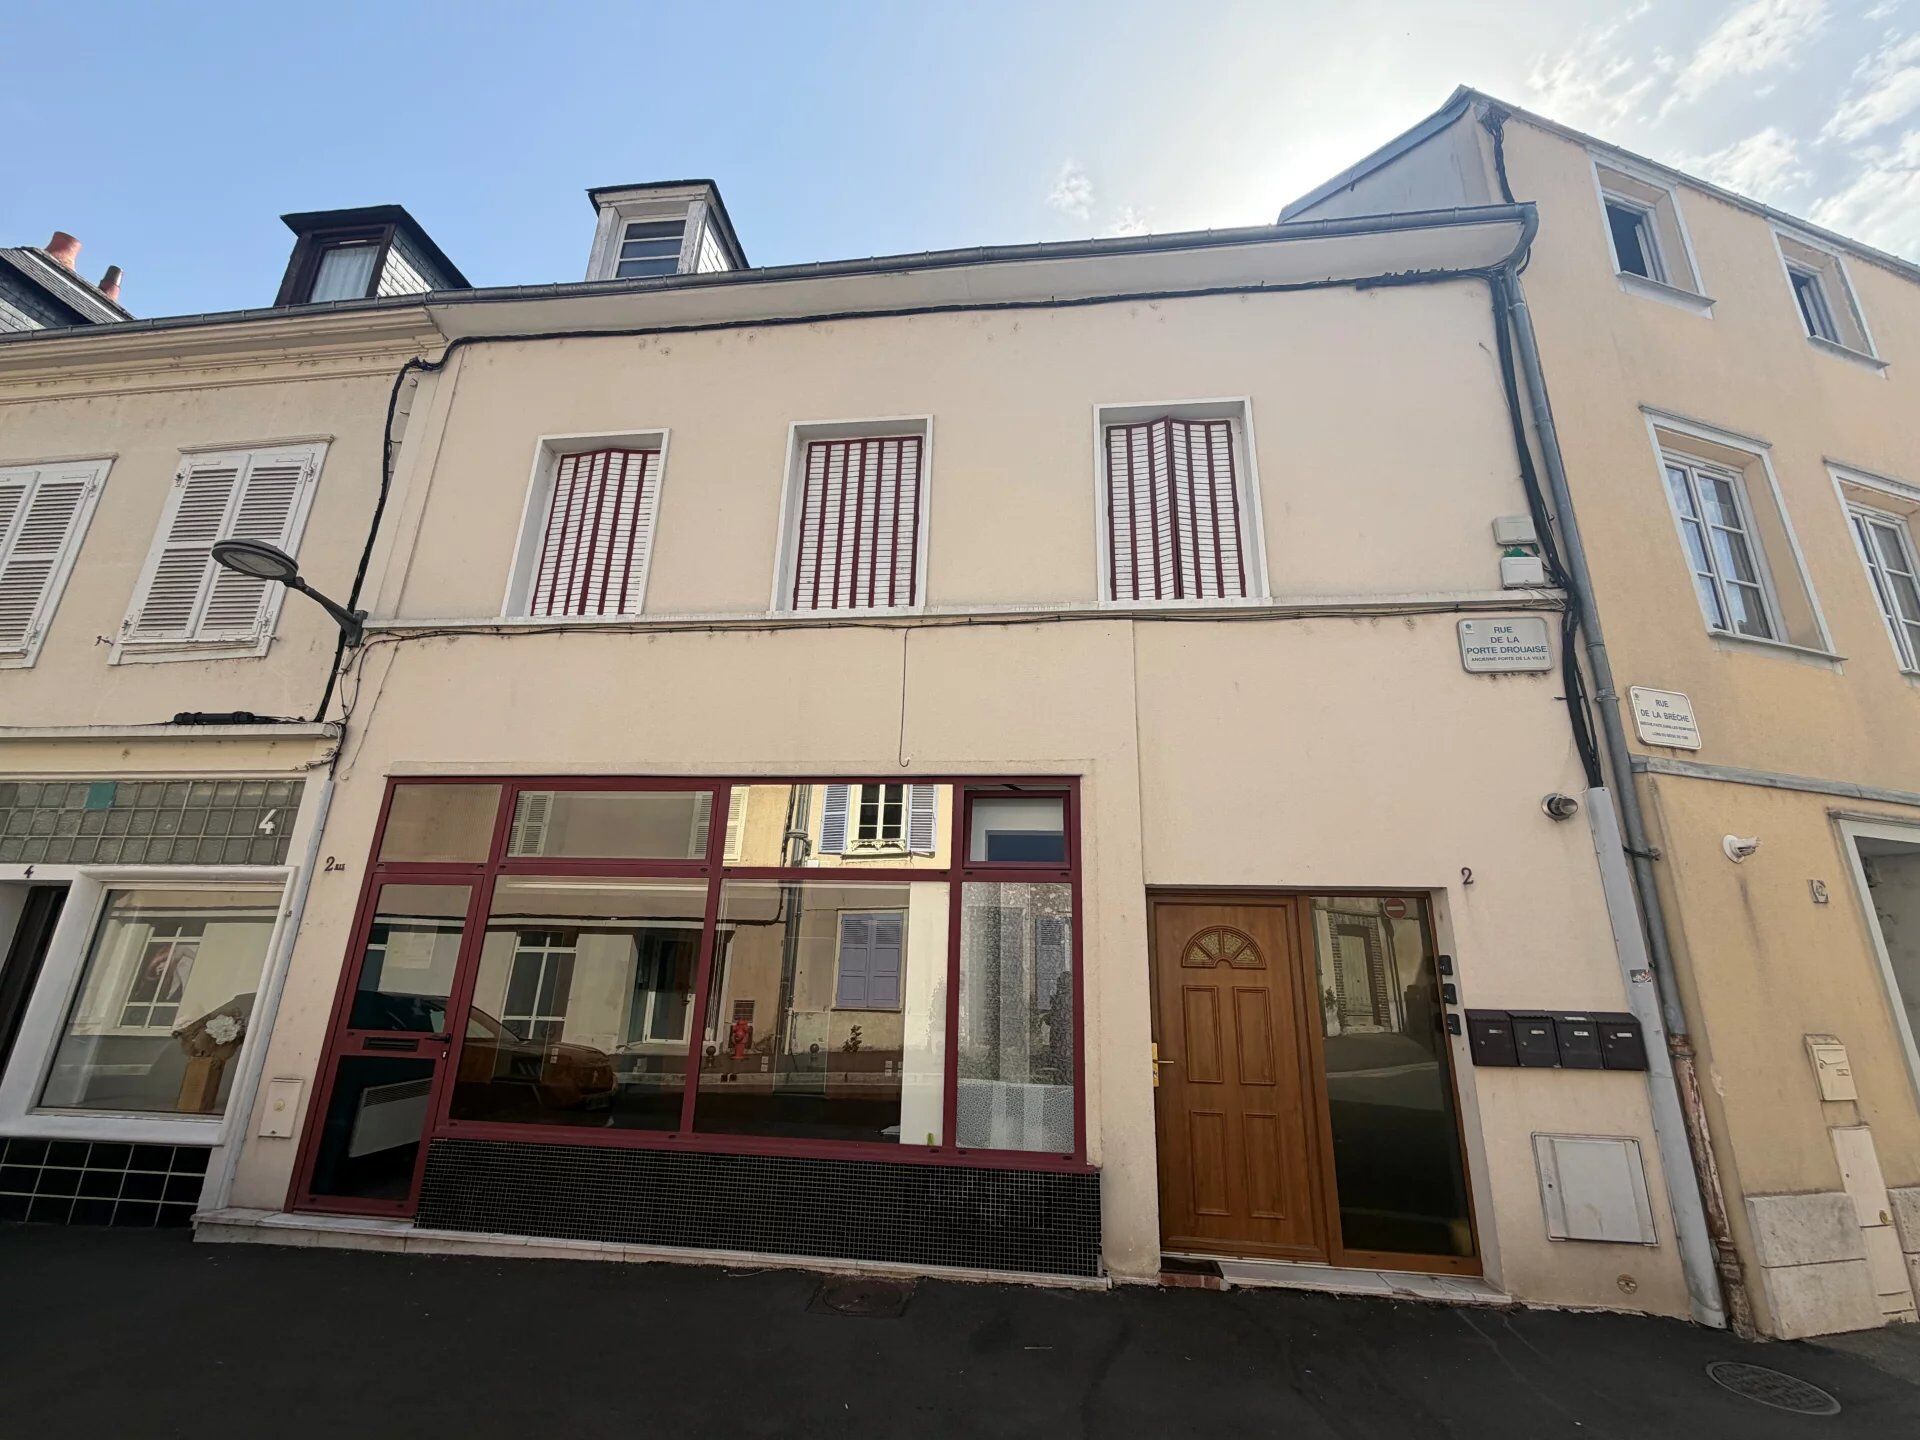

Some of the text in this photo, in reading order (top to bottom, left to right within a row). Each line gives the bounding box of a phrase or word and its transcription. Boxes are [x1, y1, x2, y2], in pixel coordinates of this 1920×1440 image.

[1493, 626, 1513, 634] RUE
[1466, 645, 1548, 654] PORTE DROUAISE
[1655, 699, 1669, 708] RUE
[1640, 709, 1650, 717] DE
[1652, 711, 1662, 719] LA
[258, 808, 277, 835] 4
[324, 856, 335, 871] 2
[23, 864, 34, 879] 4
[1461, 867, 1474, 885] 2
